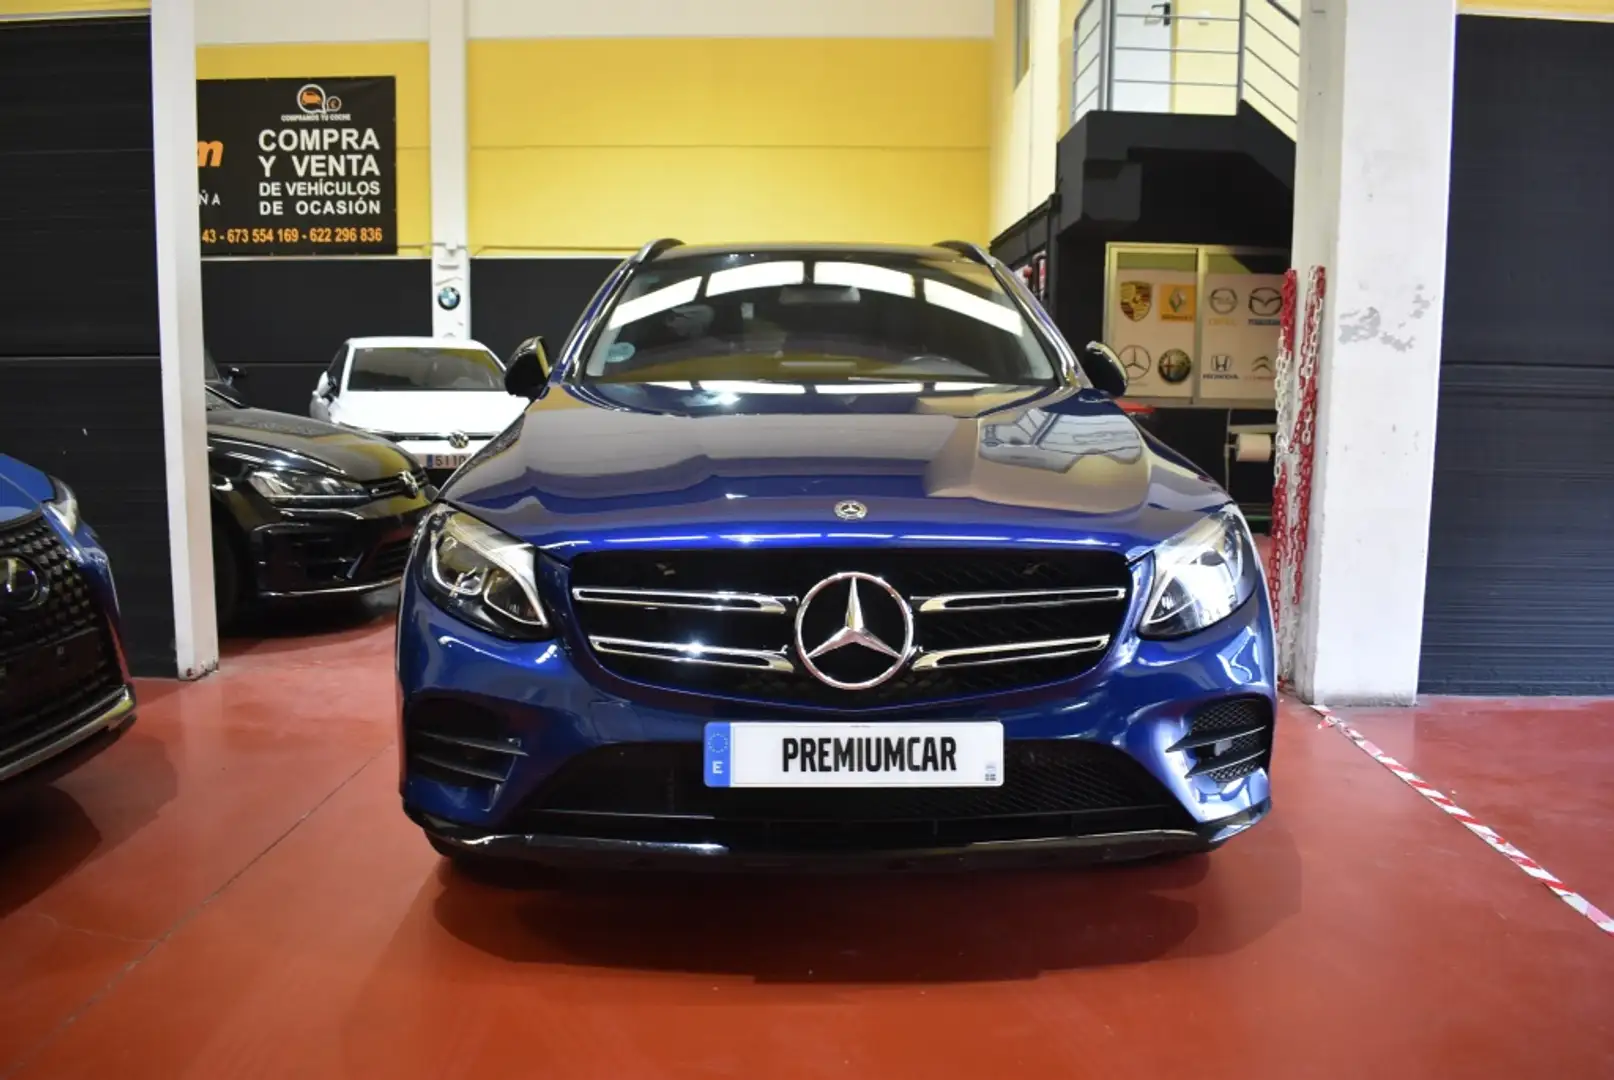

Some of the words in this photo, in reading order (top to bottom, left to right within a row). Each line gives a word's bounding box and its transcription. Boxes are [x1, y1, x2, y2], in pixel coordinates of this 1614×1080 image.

[258, 128, 380, 151] COMPRA
[258, 156, 276, 178] Y
[292, 154, 381, 178] VENTA
[259, 183, 281, 196] DE
[286, 179, 380, 196] VEHÍCULOS
[260, 201, 284, 216] DE
[296, 198, 380, 215] OCASIÓN
[227, 228, 248, 242] 673
[252, 228, 273, 242] 554
[278, 228, 299, 242] 169
[310, 228, 331, 242] 622
[336, 228, 356, 242] 296
[360, 228, 382, 242] 836
[712, 761, 724, 774] E
[782, 736, 957, 772] PREMIUMCAR
